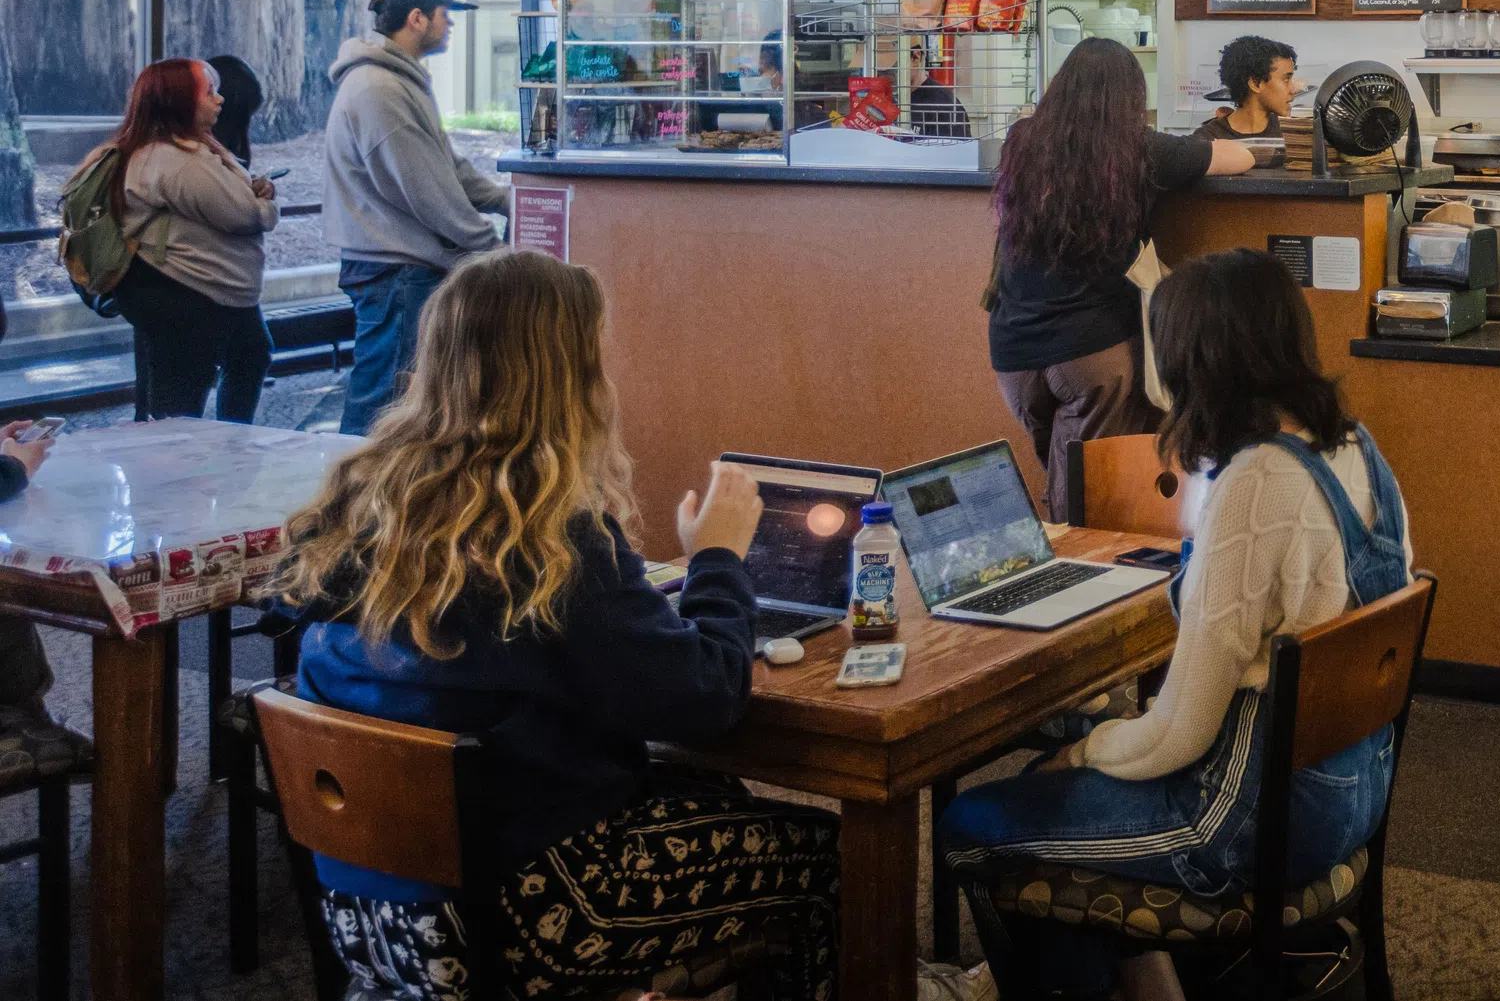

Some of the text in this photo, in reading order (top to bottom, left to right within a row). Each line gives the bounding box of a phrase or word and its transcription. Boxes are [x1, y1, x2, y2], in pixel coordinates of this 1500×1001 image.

[580, 54, 612, 66] chocolate
[580, 65, 620, 79] chip cookie
[520, 196, 561, 206] STEVENSON
[520, 216, 544, 224] COMPLETE
[519, 224, 552, 232] INGREDIENTS
[519, 238, 555, 246] INFORMATION
[867, 570, 884, 578] BLUE
[860, 578, 891, 587] MACHINE
